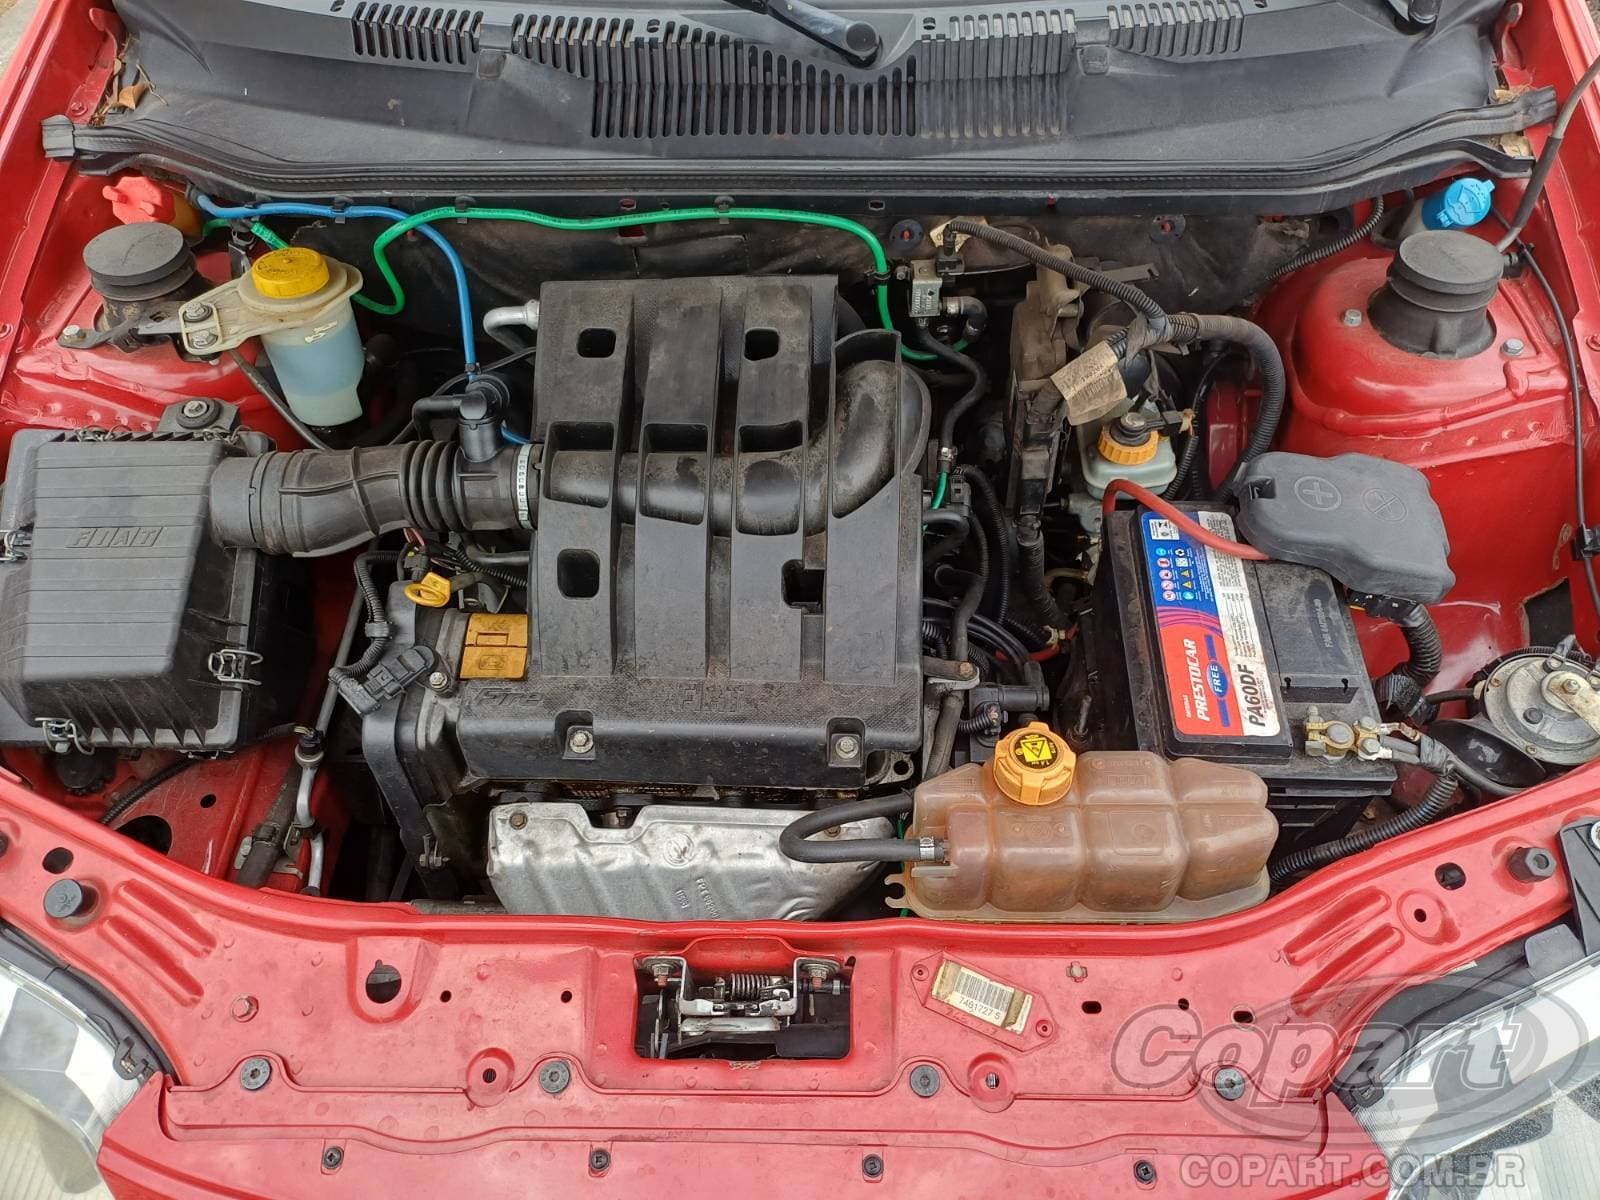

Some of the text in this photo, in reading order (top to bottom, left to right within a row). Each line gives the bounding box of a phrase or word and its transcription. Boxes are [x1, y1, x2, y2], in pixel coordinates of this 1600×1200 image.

[71, 528, 160, 546] FIAT
[1184, 638, 1210, 721] PRESTOCAR
[1211, 665, 1223, 693] FREE
[1237, 663, 1266, 727] PA60DF
